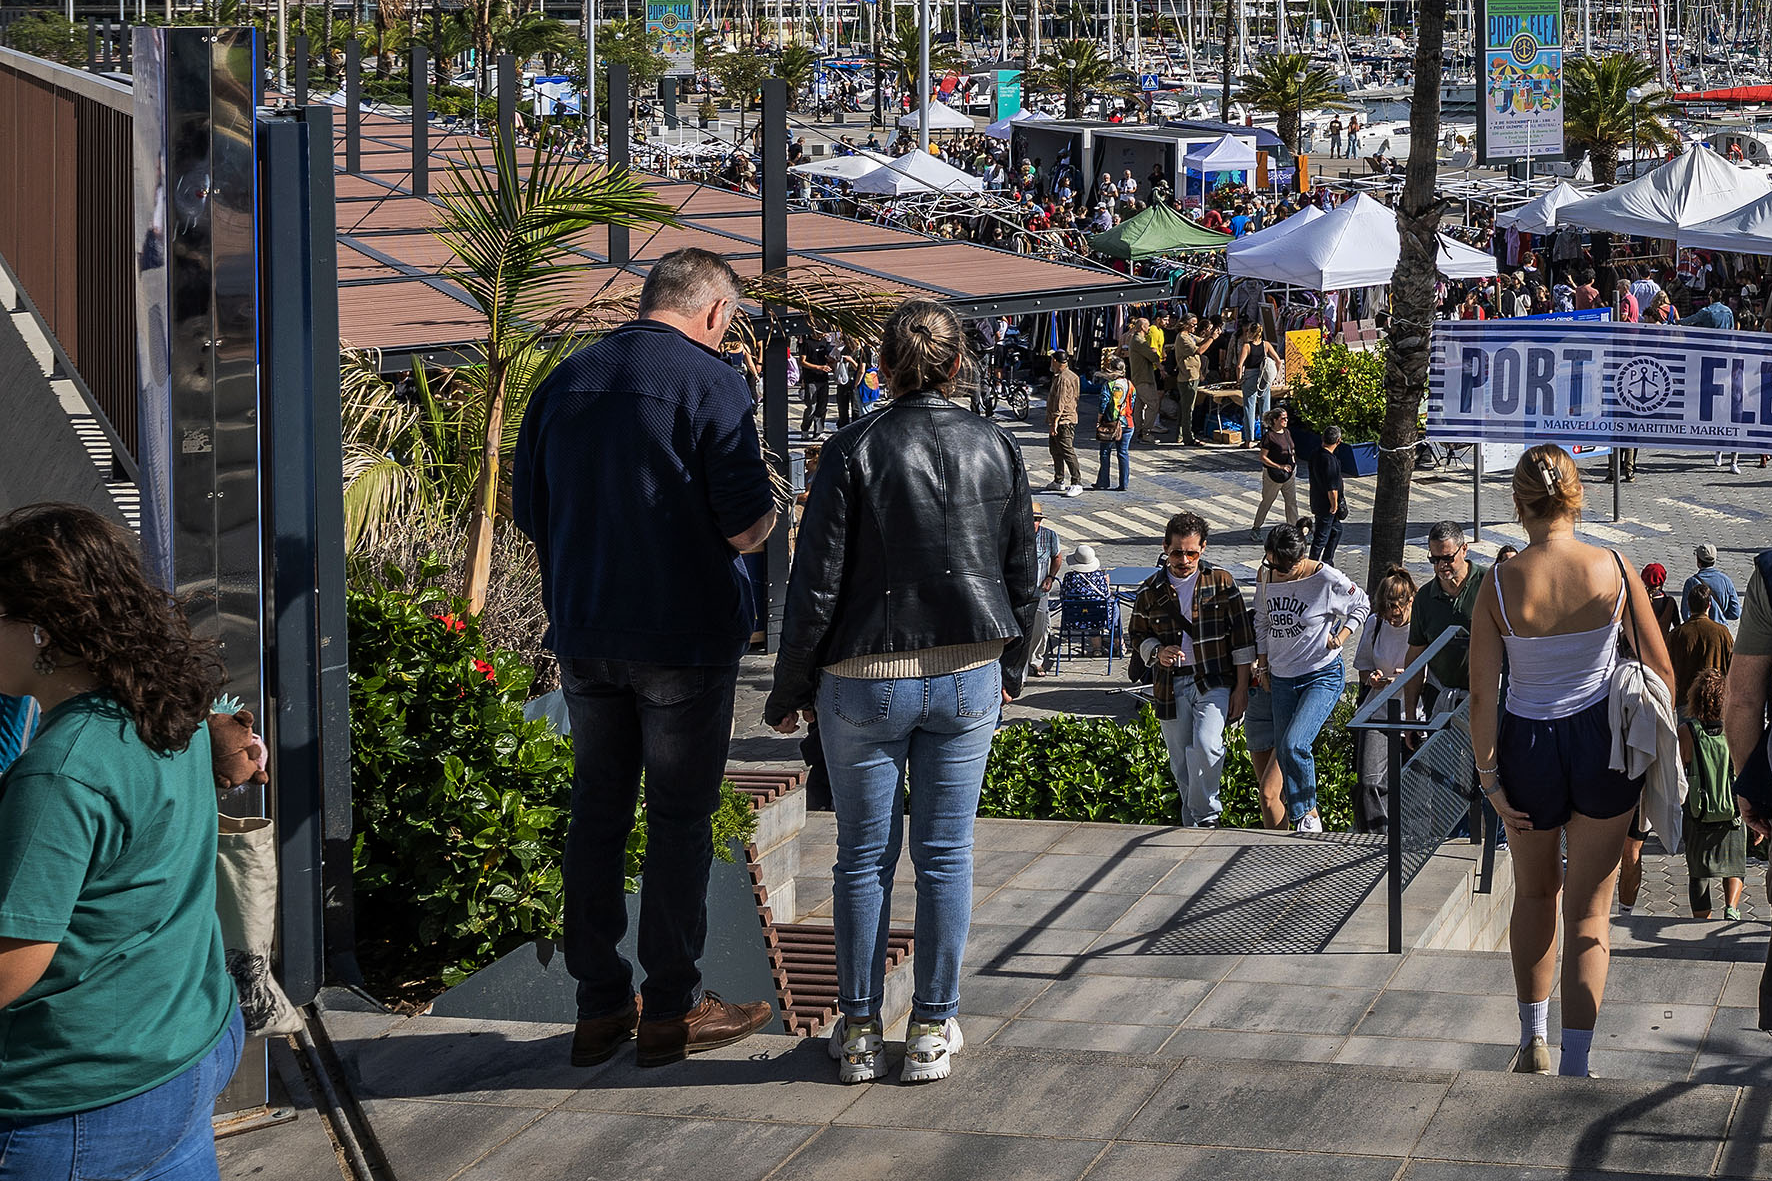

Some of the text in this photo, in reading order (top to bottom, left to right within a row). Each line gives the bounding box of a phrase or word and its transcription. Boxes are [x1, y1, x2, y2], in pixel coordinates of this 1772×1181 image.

[648, 4, 692, 20] PORT FLEA
[1489, 14, 1559, 47] PORT FLEA
[1460, 347, 1593, 417] PORT
[1631, 370, 1658, 382] P F
[1543, 419, 1740, 437] MARVELLOUS MARITIME MARKET
[1266, 597, 1308, 617] ONDON
[1270, 613, 1294, 626] 1986
[1285, 621, 1307, 639] PARK
